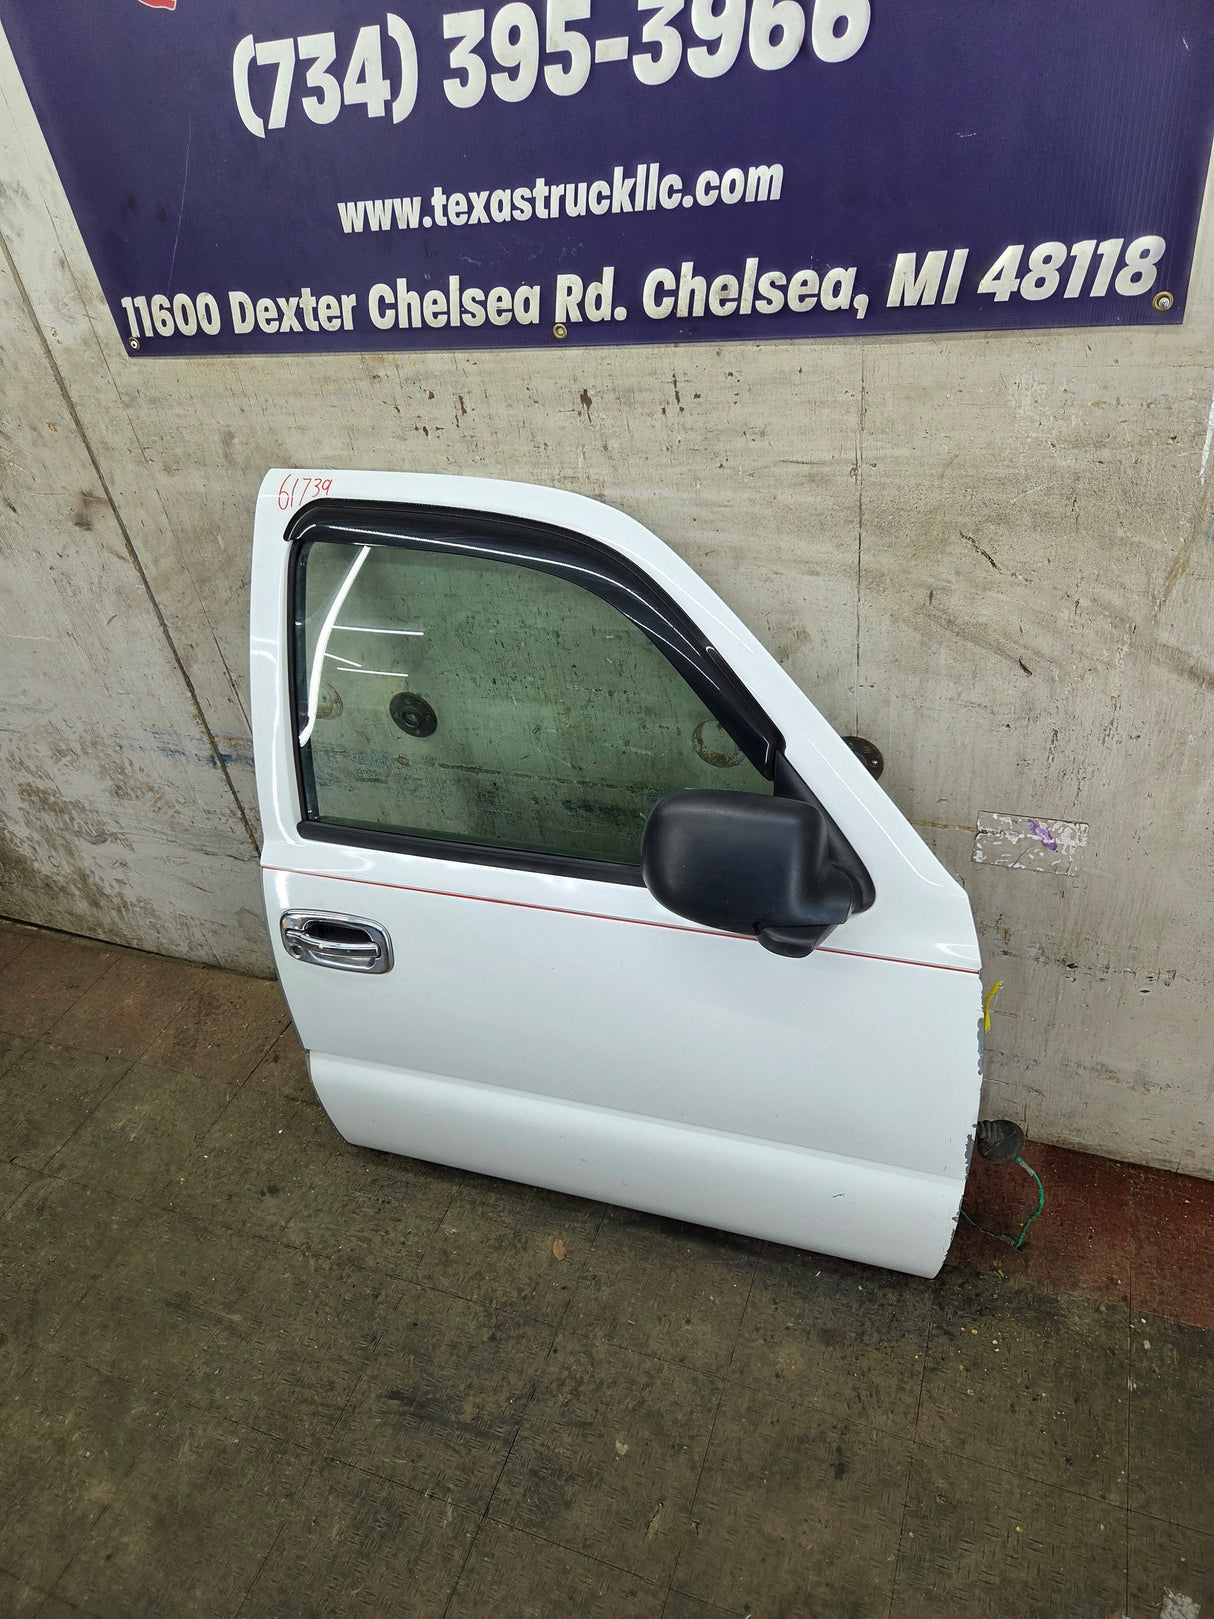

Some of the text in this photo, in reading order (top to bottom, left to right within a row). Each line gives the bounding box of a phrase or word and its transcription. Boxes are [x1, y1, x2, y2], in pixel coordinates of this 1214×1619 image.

[233, 13, 418, 138] (734)
[337, 163, 783, 233] www.texastruckllc.com
[121, 236, 1165, 338] 11600 Dexter Chelsea Rd. Chelsea, MI 48118
[278, 473, 333, 510] 61739
